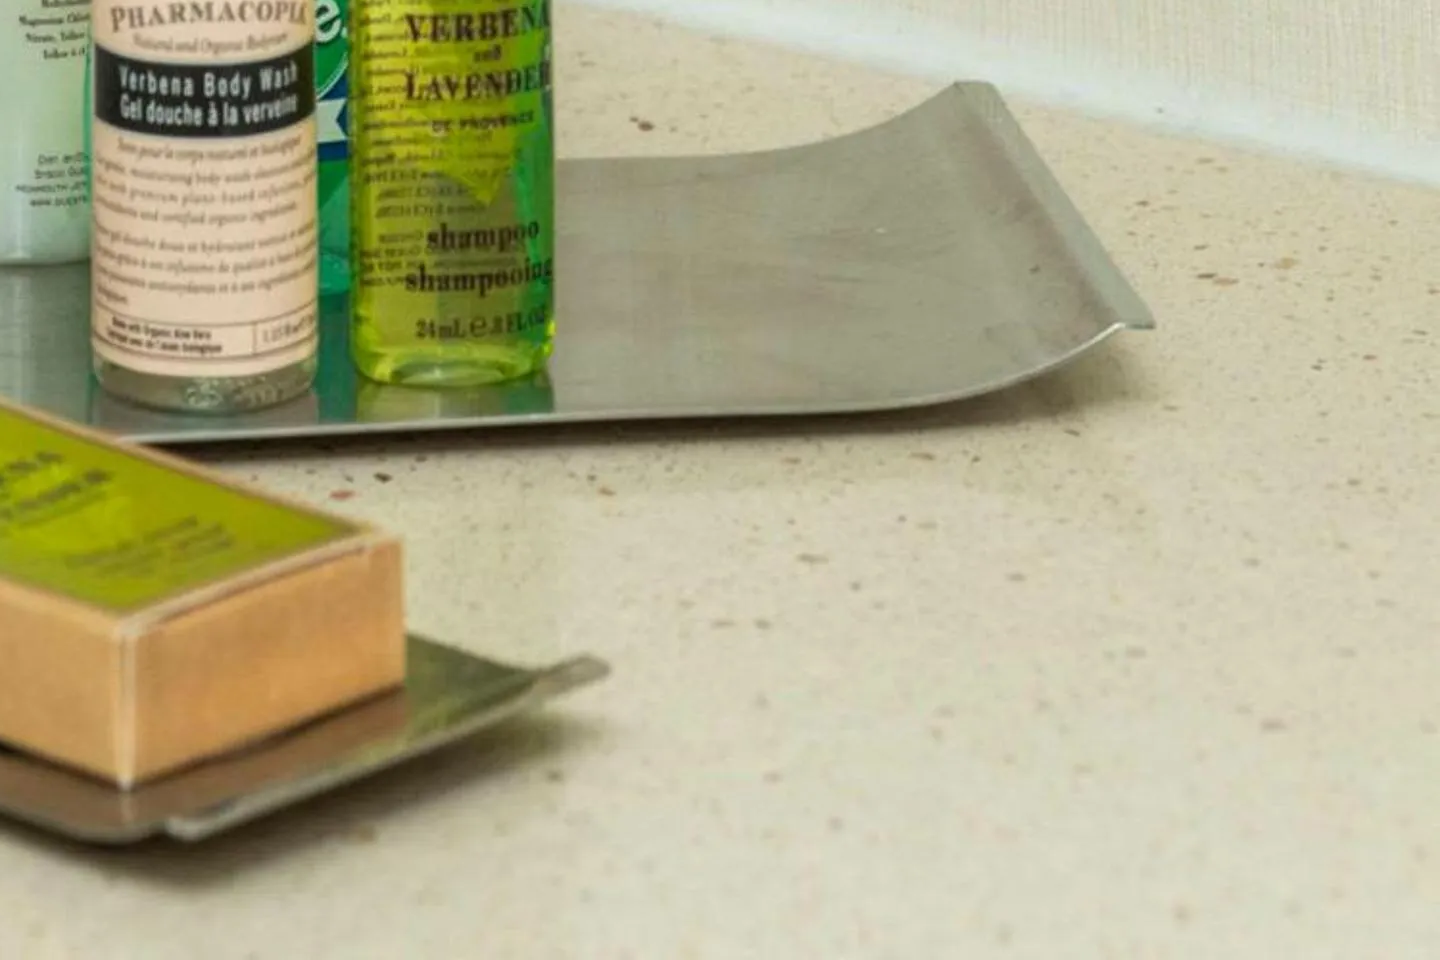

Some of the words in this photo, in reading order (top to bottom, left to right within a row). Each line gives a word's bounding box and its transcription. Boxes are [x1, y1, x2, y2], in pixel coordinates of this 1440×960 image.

[119, 64, 194, 97] Verbena
[203, 71, 252, 100] Body
[259, 59, 298, 92] Wash
[120, 92, 143, 120] Gel
[146, 100, 203, 127] douche
[208, 101, 218, 127] à
[223, 100, 239, 127] la
[427, 221, 539, 252] shampoo
